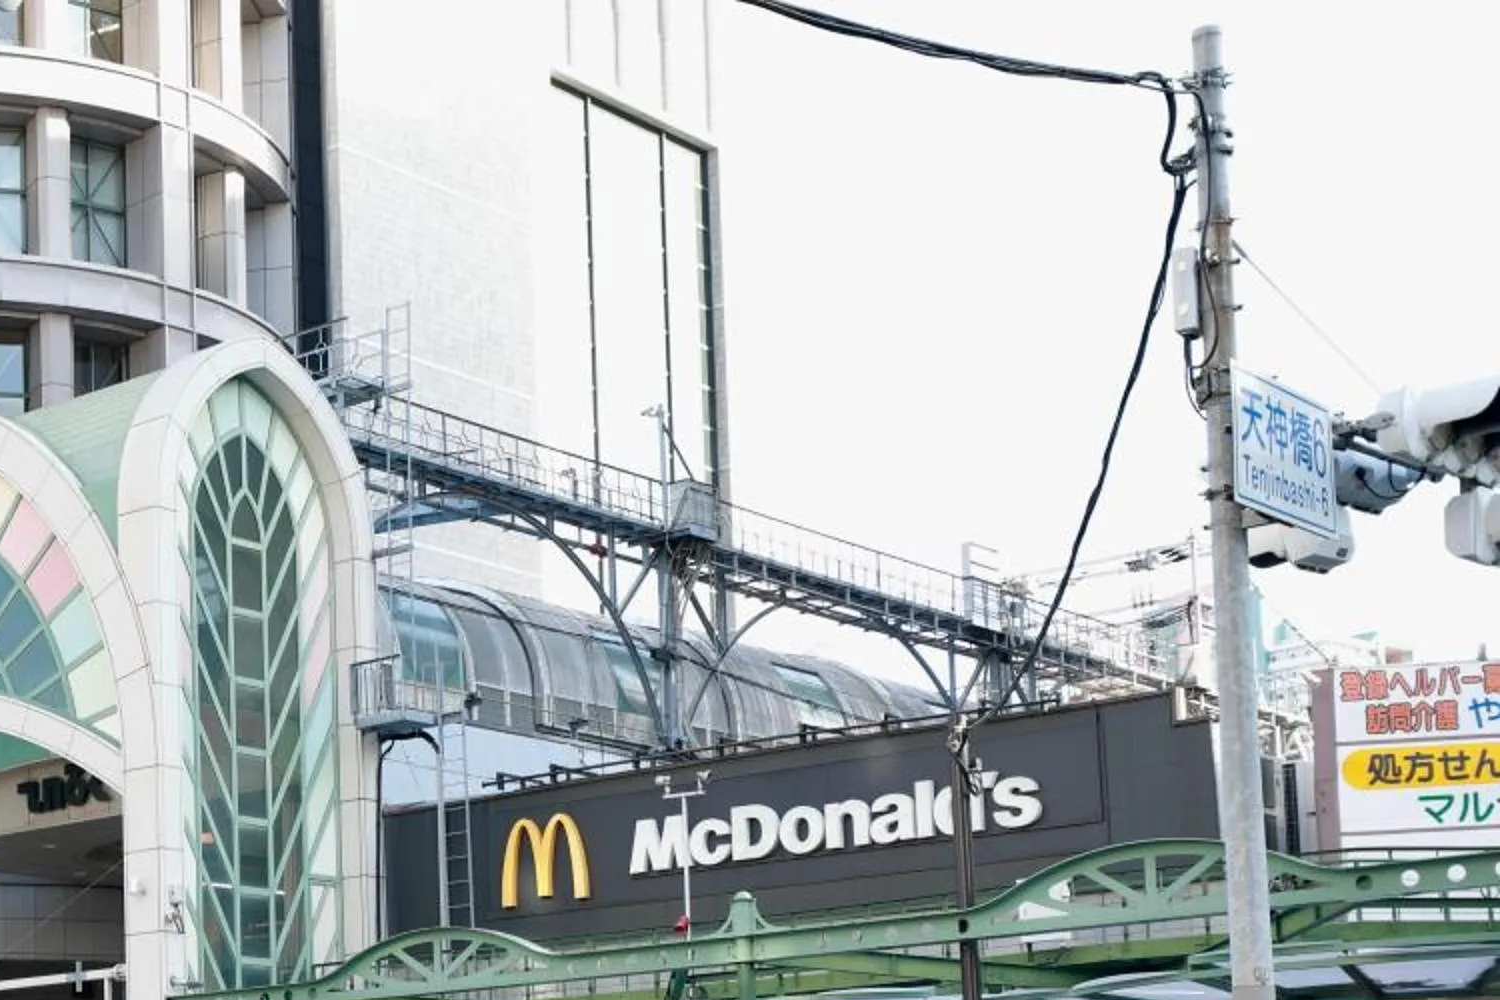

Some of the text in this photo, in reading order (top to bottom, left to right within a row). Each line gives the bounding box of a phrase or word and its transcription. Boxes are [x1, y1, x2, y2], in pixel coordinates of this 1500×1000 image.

[1240, 387, 1326, 478] 天神橋6
[1365, 699, 1459, 735] 訪問介護
[1367, 748, 1500, 786] 処方せん
[629, 774, 1043, 875] McDonald's
[1417, 791, 1500, 824] マル
